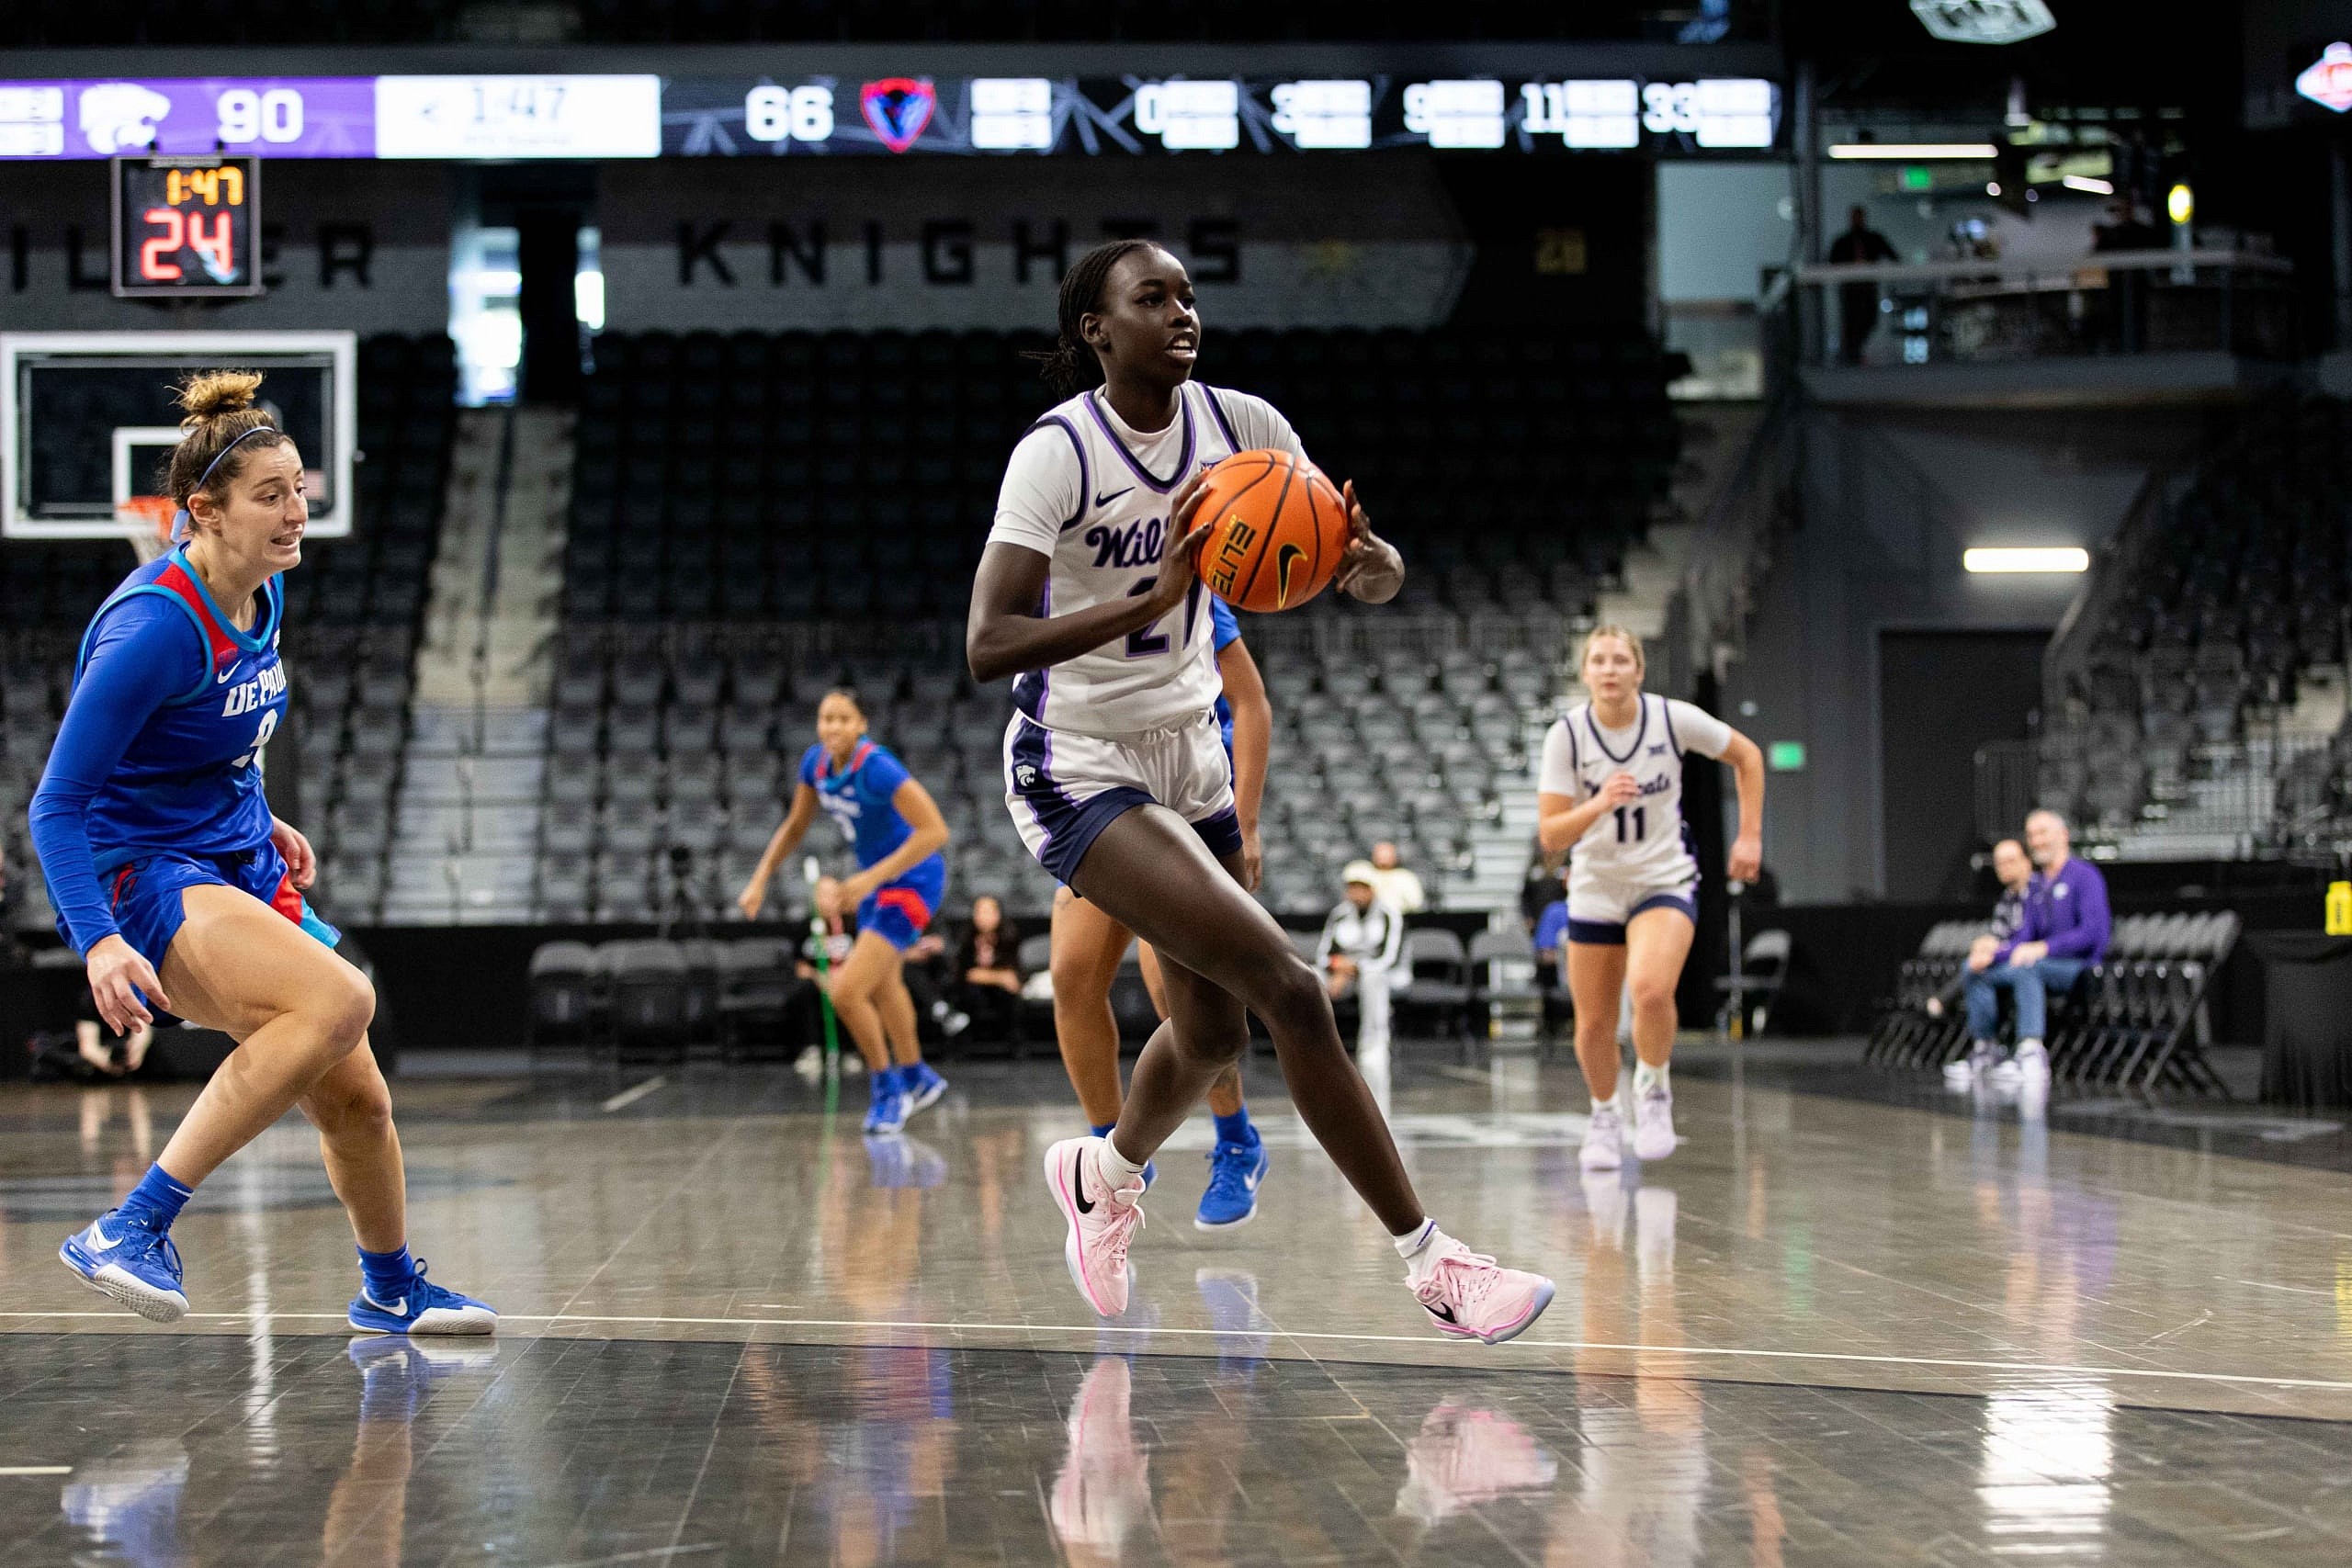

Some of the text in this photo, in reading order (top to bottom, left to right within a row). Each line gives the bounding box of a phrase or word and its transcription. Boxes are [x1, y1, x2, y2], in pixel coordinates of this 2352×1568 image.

[218, 89, 303, 143] 90
[745, 86, 833, 141] 66
[1521, 83, 1563, 133] 11
[1643, 83, 1698, 133] 33
[166, 166, 243, 206] 1:47
[141, 209, 232, 279] 24
[1085, 516, 1170, 568] Wil
[1211, 520, 1257, 596] ELITE
[1613, 806, 1645, 844] 11
